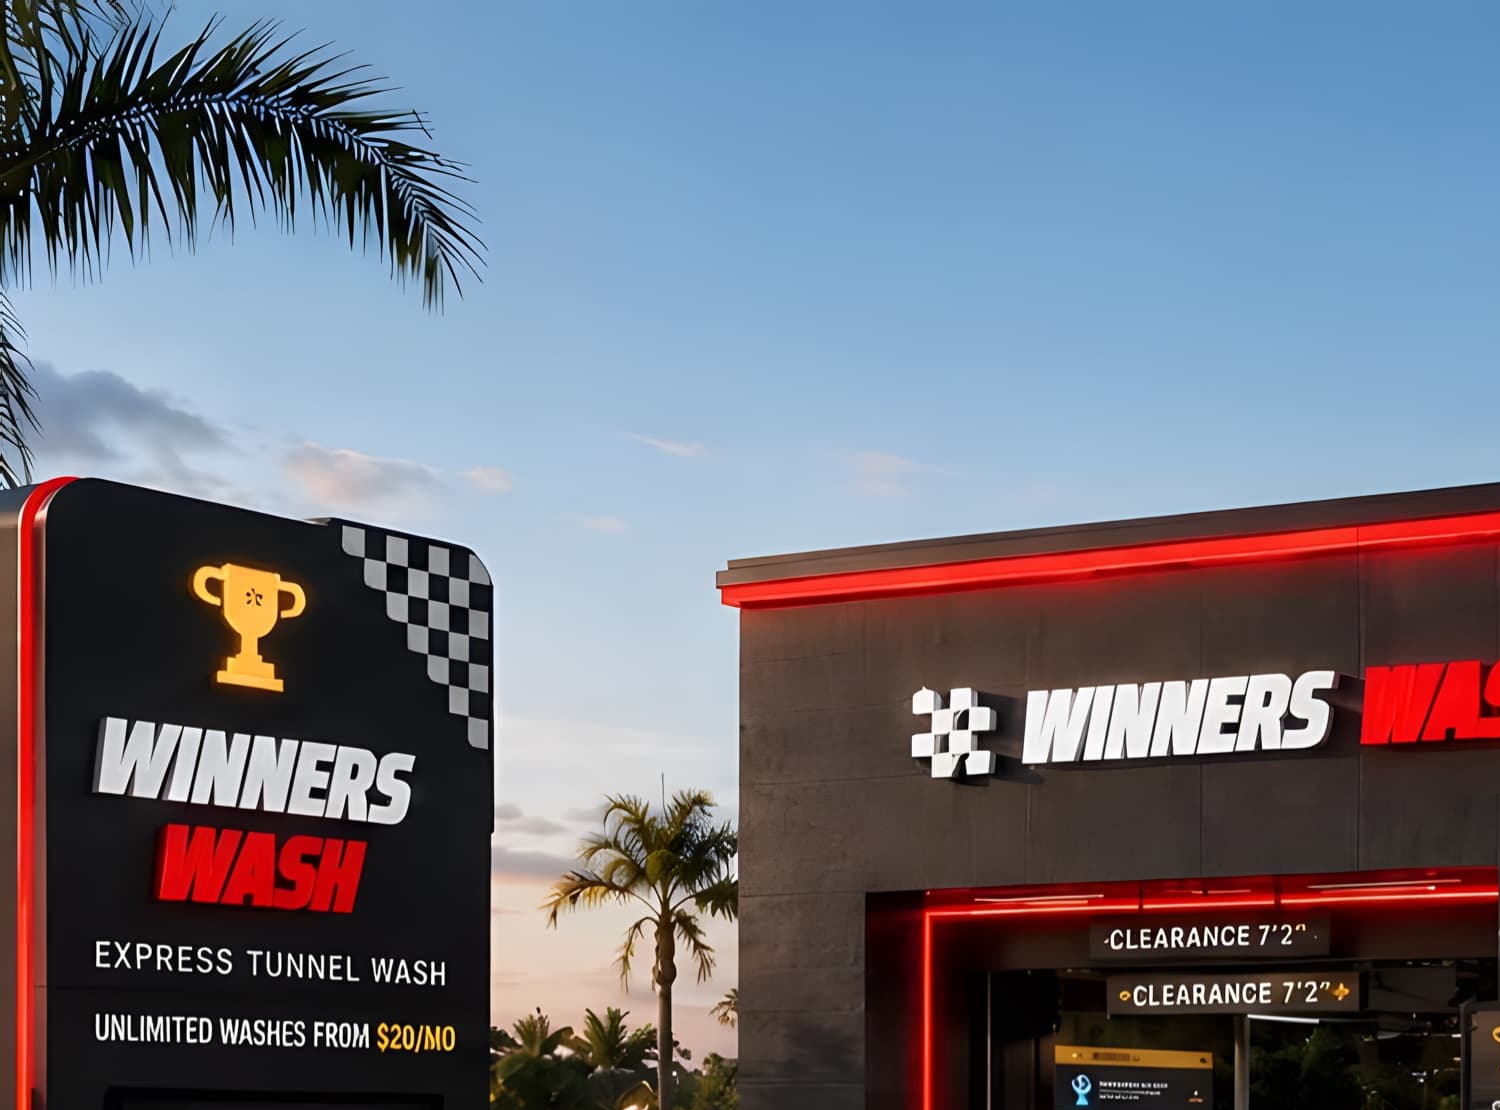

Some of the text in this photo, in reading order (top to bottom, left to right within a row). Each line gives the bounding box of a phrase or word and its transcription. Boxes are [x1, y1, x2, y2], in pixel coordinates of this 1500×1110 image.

[1021, 670, 1336, 765] WINNERS
[94, 716, 417, 825] WINNERS
[157, 822, 368, 914] WASH
[1109, 924, 1251, 951] CLEARANCE
[94, 940, 447, 987] EXPRESS TUNNEL WASH
[1132, 979, 1332, 1007] CLEARANCE 7'2"
[94, 1012, 457, 1055] UNLIMITED WASHES FROM $20/MO
